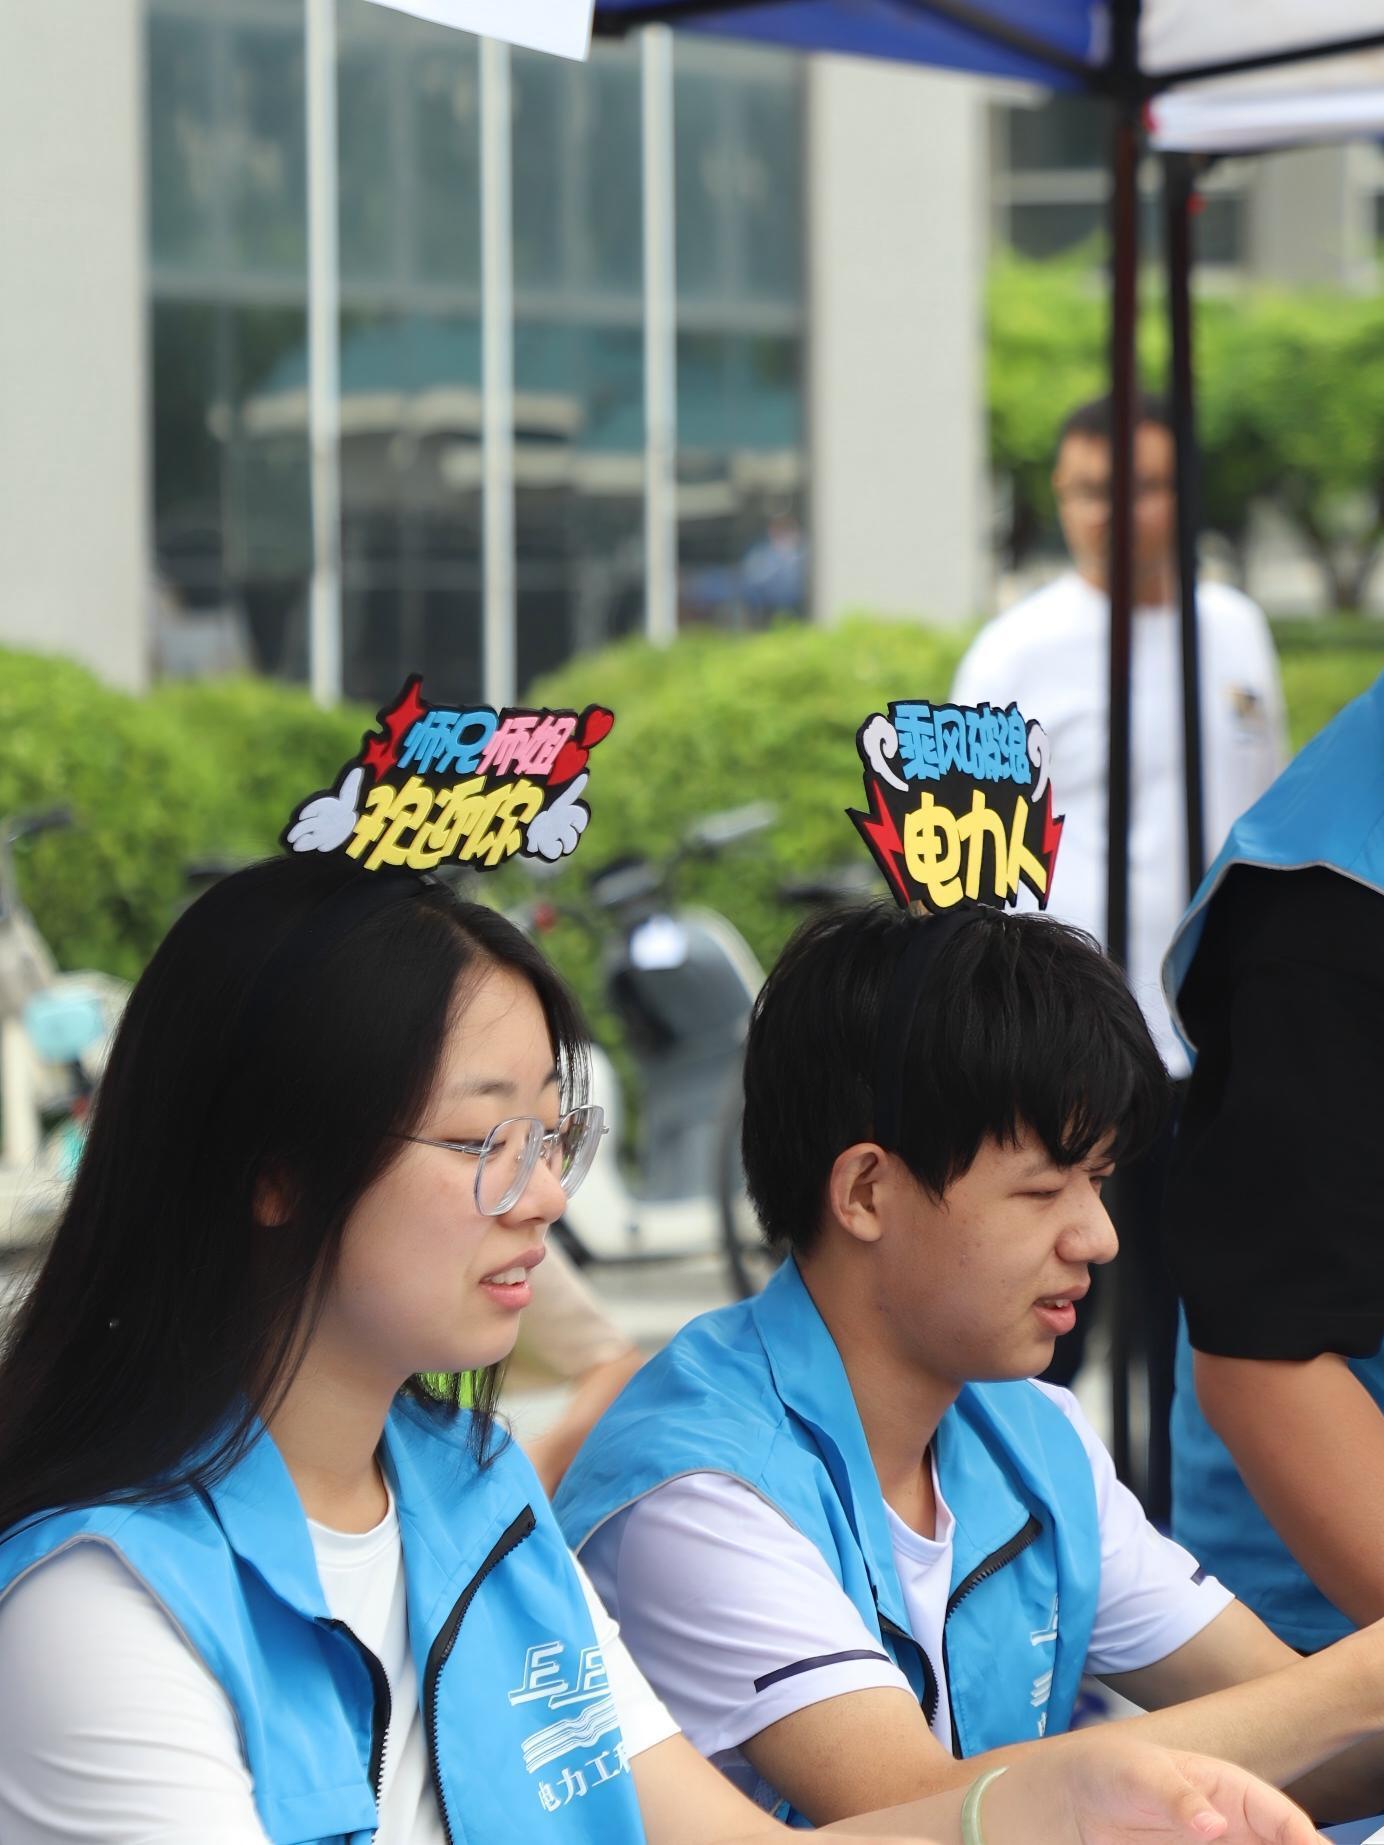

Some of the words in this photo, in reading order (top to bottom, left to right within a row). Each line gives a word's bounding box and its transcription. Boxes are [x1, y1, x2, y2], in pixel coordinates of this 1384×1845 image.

[396, 711, 578, 776] 师兄师姐
[894, 704, 1031, 784] 乘风破浪
[903, 789, 1048, 908] 电力人
